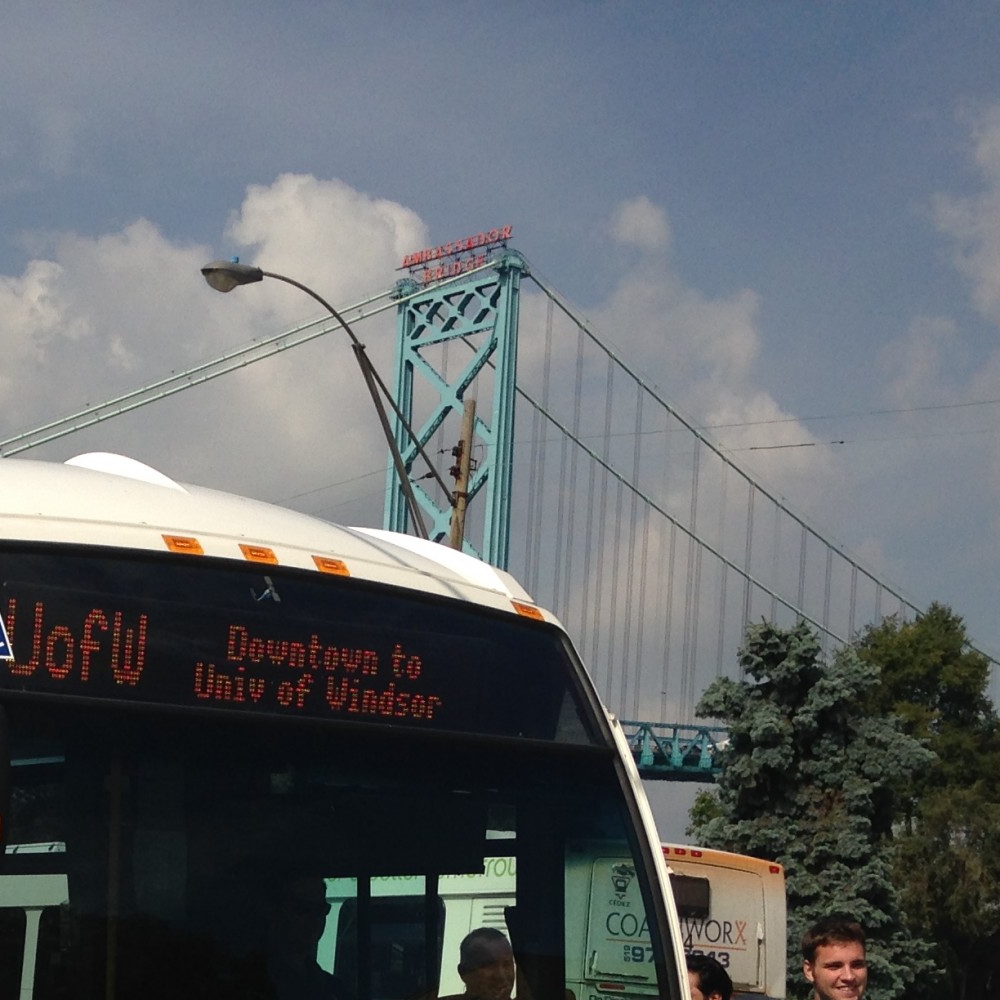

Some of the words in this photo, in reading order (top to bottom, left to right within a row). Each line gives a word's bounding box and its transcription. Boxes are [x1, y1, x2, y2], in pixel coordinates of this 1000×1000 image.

[4, 598, 148, 686] UofW
[228, 625, 379, 676] Downtown
[392, 643, 422, 680] to
[194, 662, 265, 703] Univ
[277, 673, 314, 707] of
[326, 676, 442, 719] Windsor
